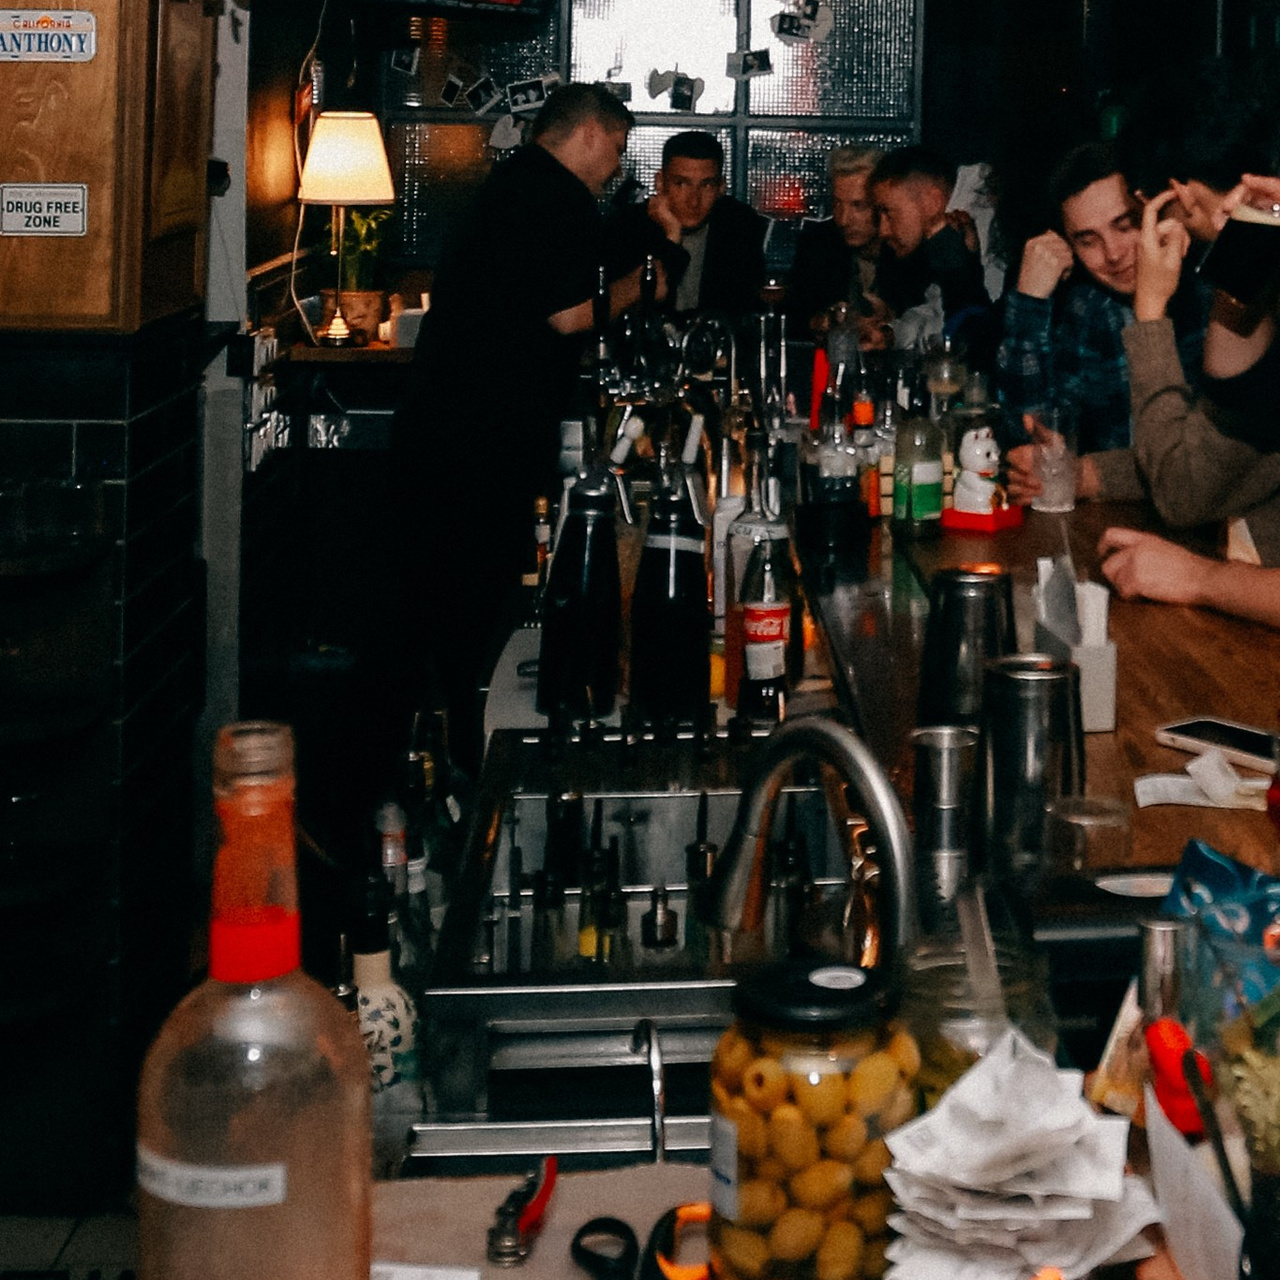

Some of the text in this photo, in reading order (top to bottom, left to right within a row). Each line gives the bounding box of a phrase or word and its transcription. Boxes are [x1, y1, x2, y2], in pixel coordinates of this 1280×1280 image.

[12, 19, 72, 30] CALIFORNIA
[6, 200, 80, 214] DRUG FREE
[24, 215, 61, 228] ZONE
